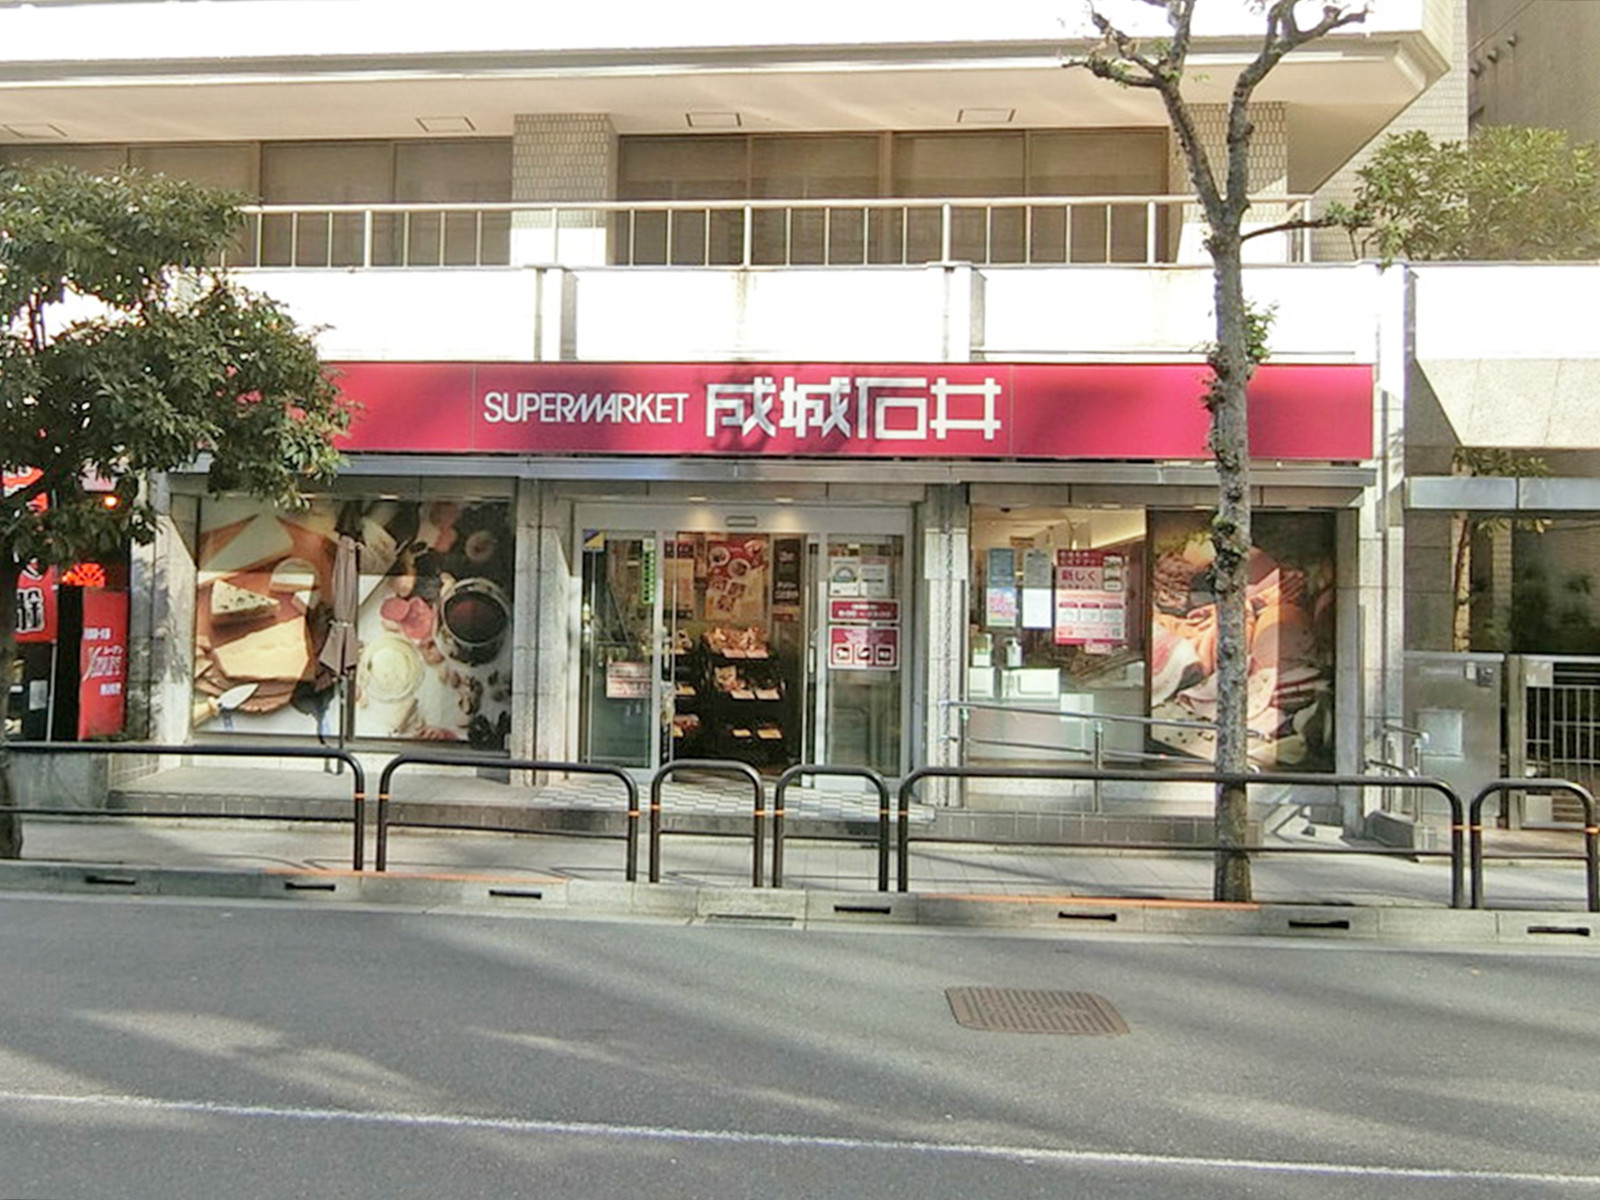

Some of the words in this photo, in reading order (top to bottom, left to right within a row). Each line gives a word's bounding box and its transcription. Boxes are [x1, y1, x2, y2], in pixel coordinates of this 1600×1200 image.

[483, 390, 690, 425] SUPERMARKET
[705, 376, 1002, 441] 成城石井
